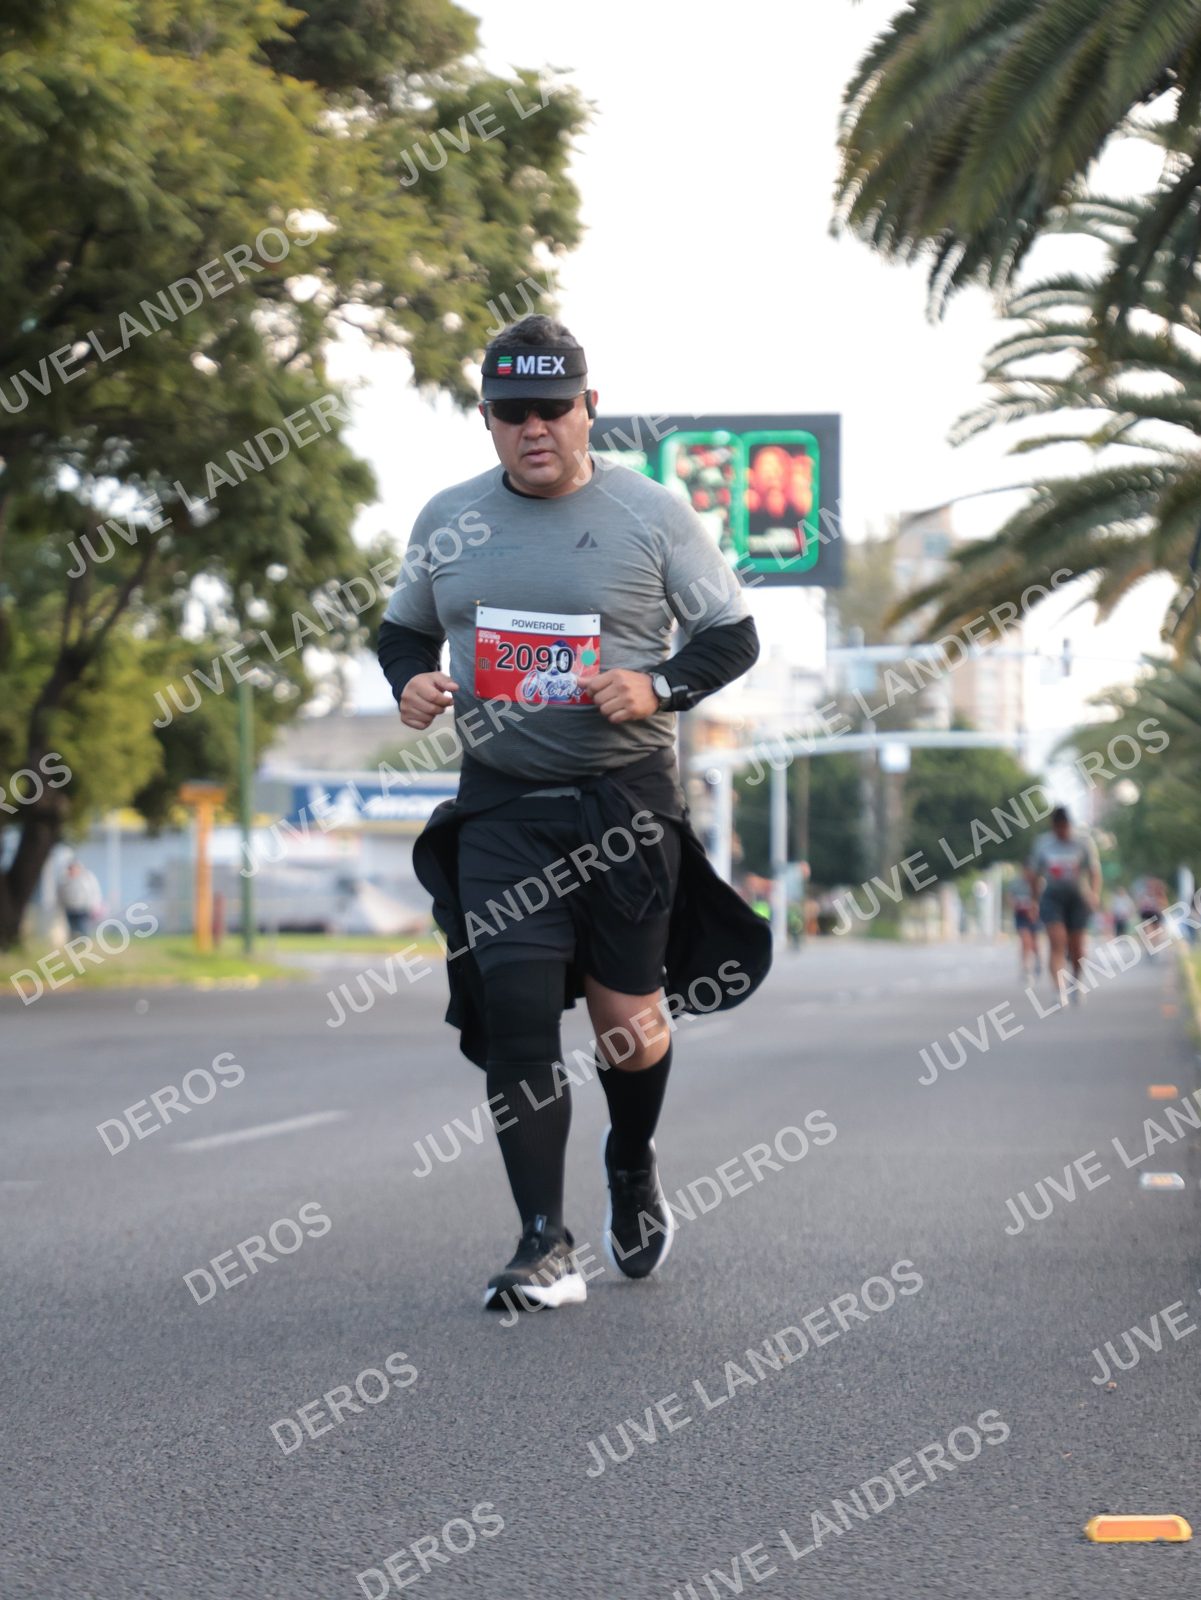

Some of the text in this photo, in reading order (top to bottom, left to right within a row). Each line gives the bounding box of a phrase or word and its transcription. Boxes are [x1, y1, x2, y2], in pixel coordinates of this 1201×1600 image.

[516, 355, 565, 375] MEX
[511, 618, 566, 631] POWERADE
[496, 642, 574, 673] 2090
